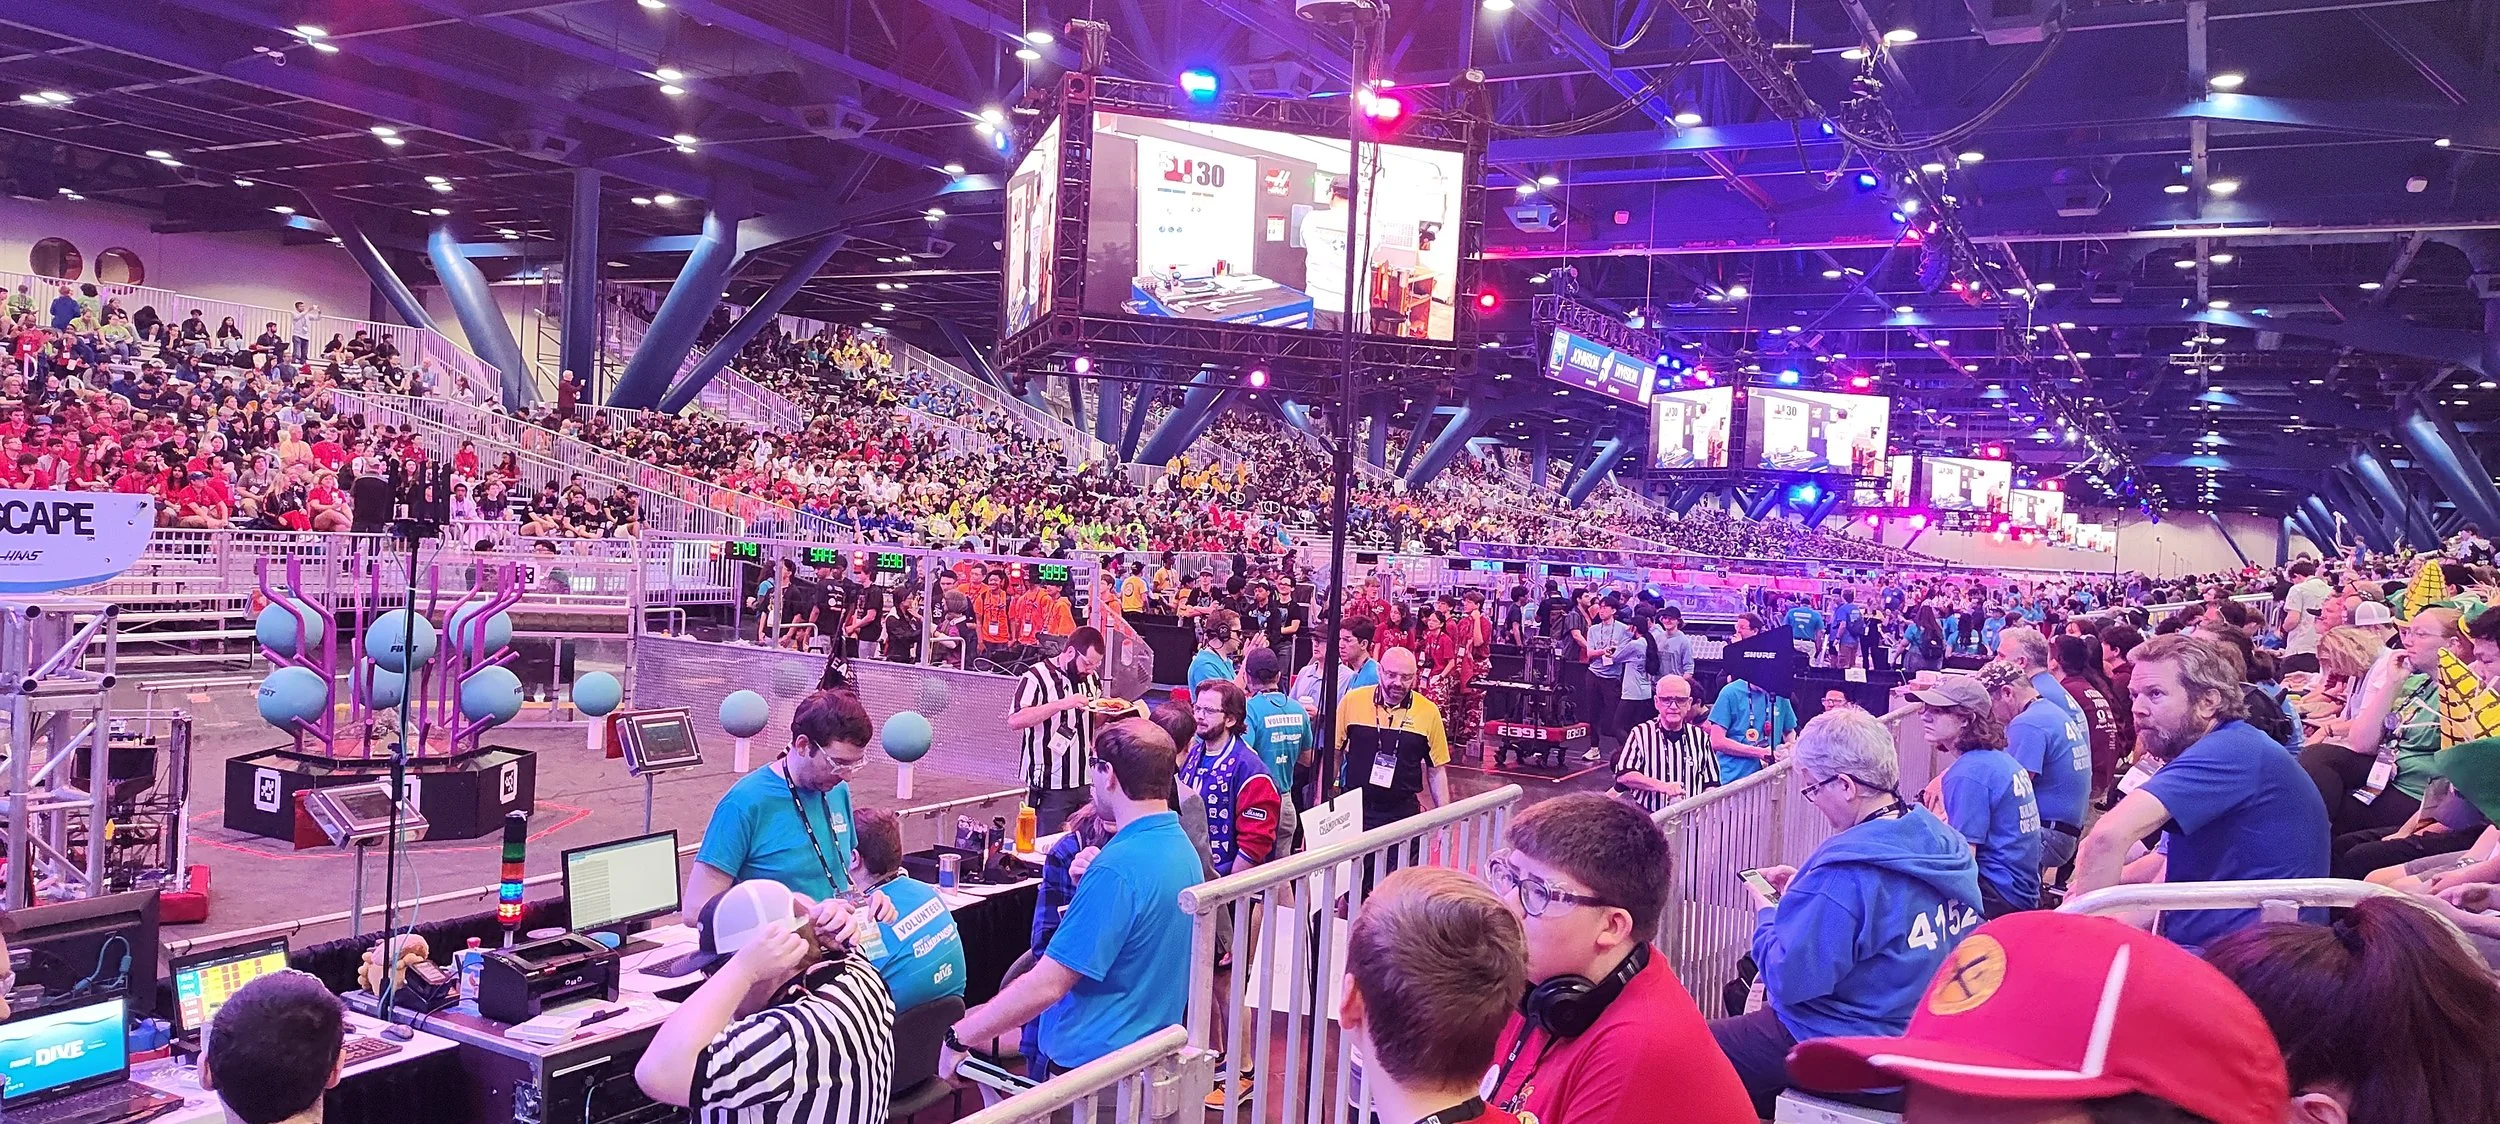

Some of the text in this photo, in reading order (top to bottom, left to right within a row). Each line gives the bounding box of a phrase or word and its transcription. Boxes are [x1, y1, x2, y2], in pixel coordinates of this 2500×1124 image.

[1197, 161, 1225, 188] 30
[1570, 347, 1601, 371] JOHNSON
[1614, 362, 1640, 384] DIVISION
[1786, 405, 1797, 416] 30
[0, 500, 94, 536] CAPE
[733, 541, 757, 557] 3748
[810, 546, 836, 564] SAFE
[1038, 563, 1068, 581] 5895
[390, 645, 418, 653] FIRT
[1743, 651, 1777, 659] SHURE
[1907, 898, 1978, 951] 4152
[933, 963, 953, 985] DIVE
[34, 1039, 85, 1067] DIVE
